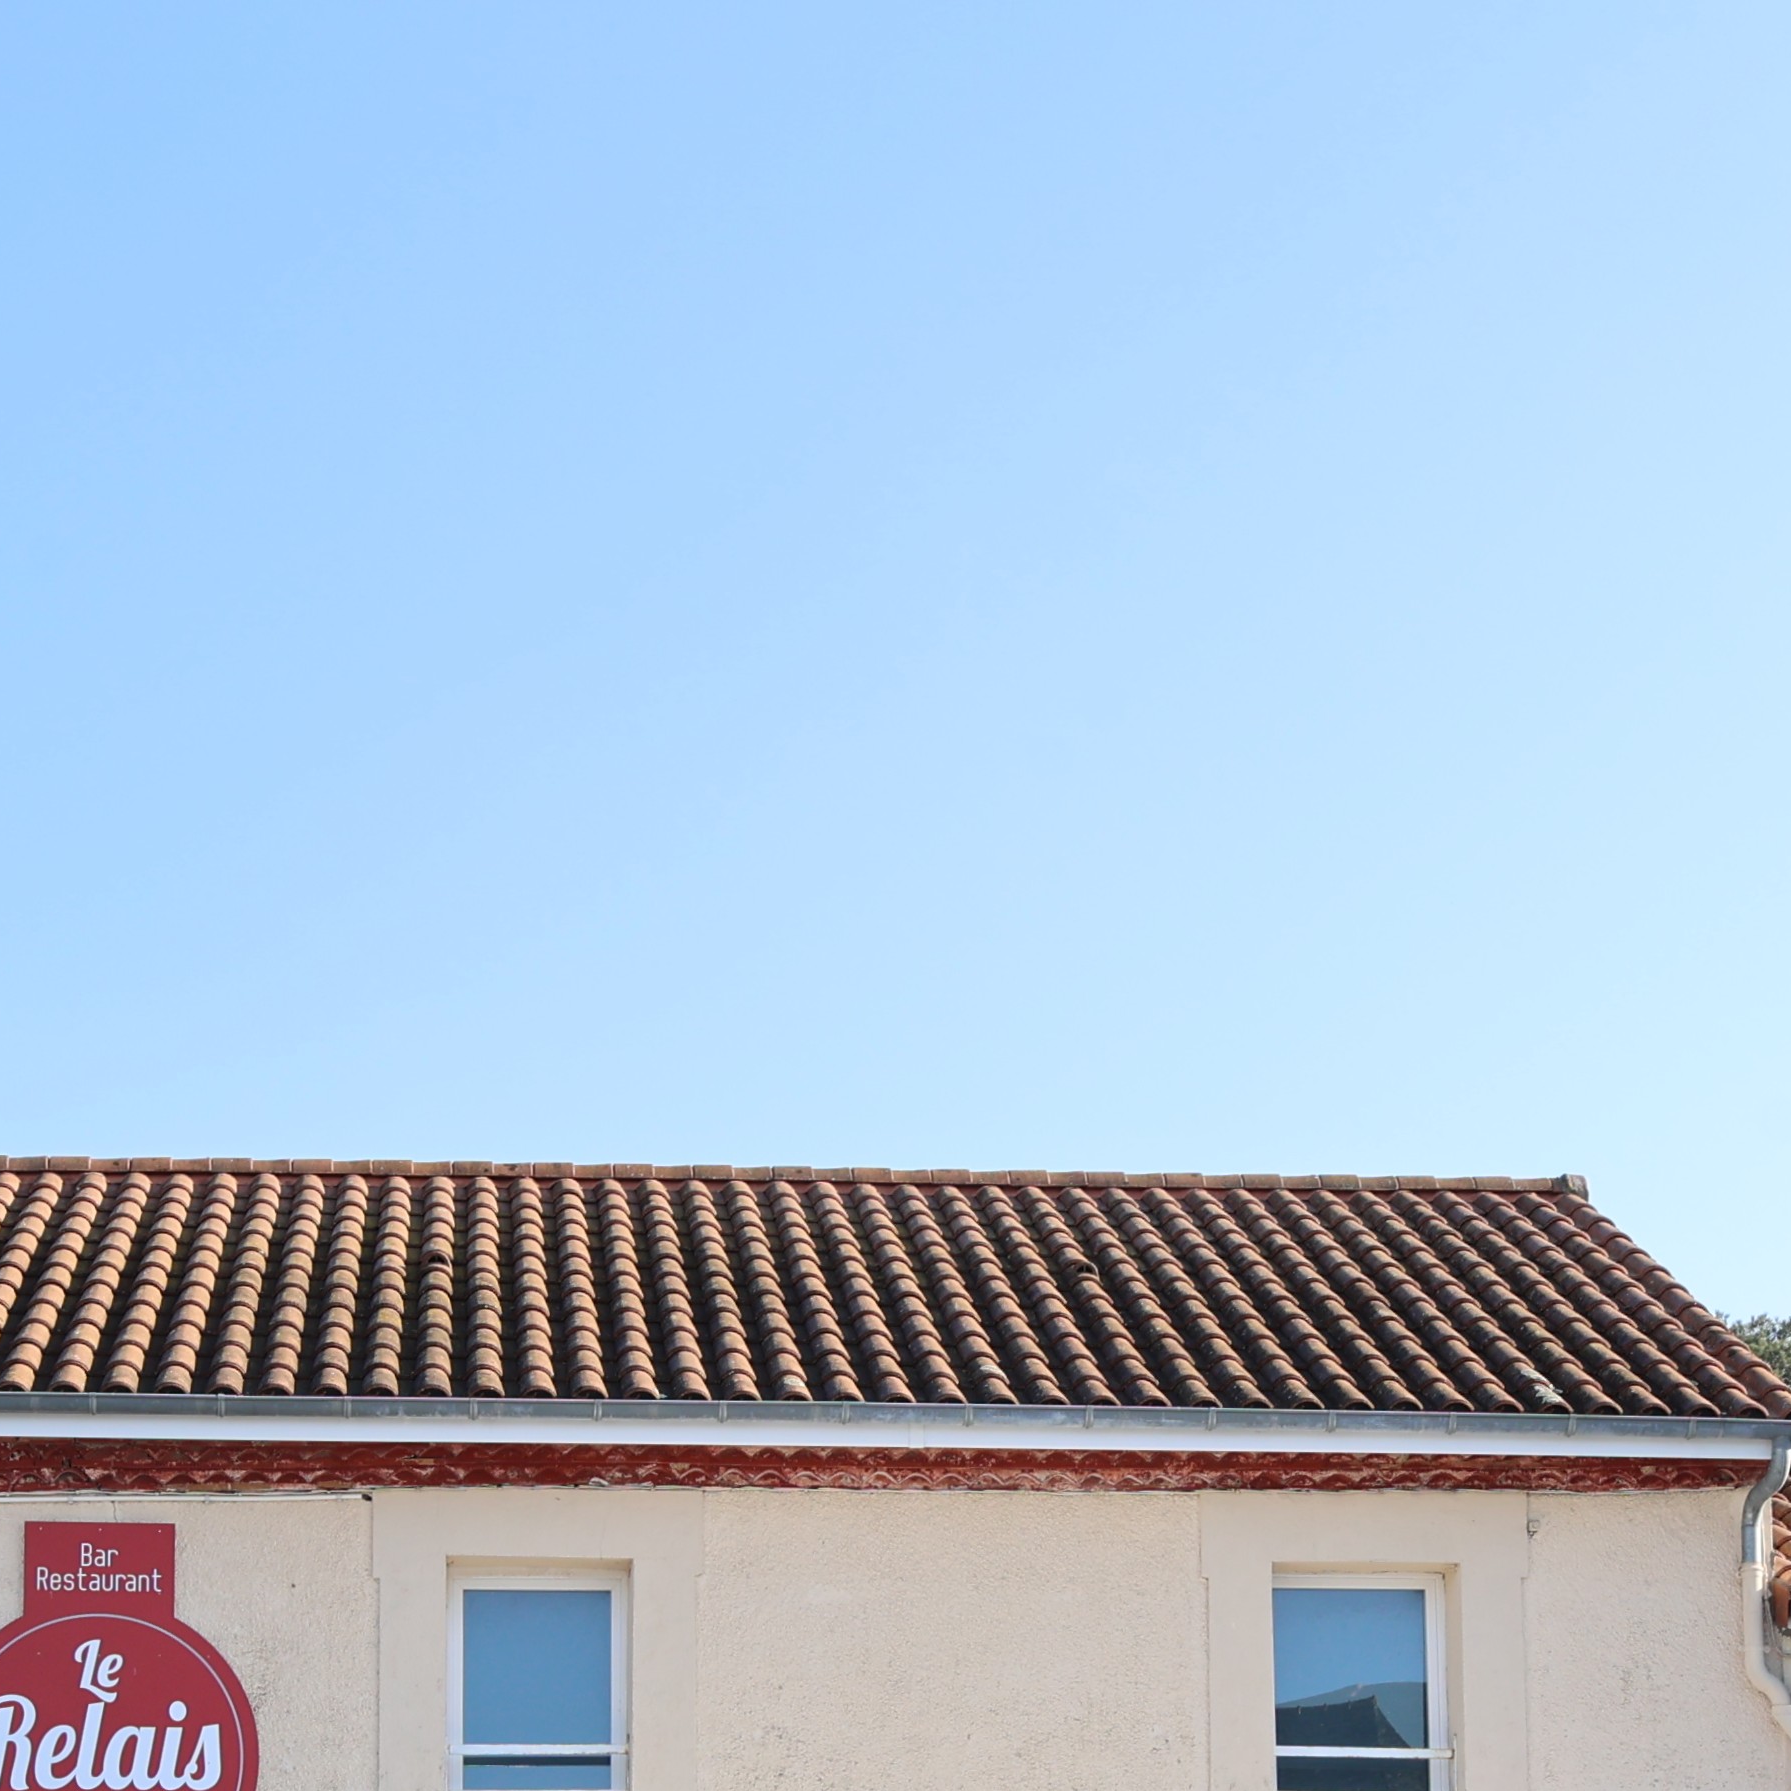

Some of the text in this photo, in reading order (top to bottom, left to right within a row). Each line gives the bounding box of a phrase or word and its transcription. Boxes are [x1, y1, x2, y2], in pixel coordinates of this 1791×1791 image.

[80, 1543, 119, 1567] Bar
[36, 1567, 162, 1593] Restaurant
[74, 1638, 124, 1703] Le
